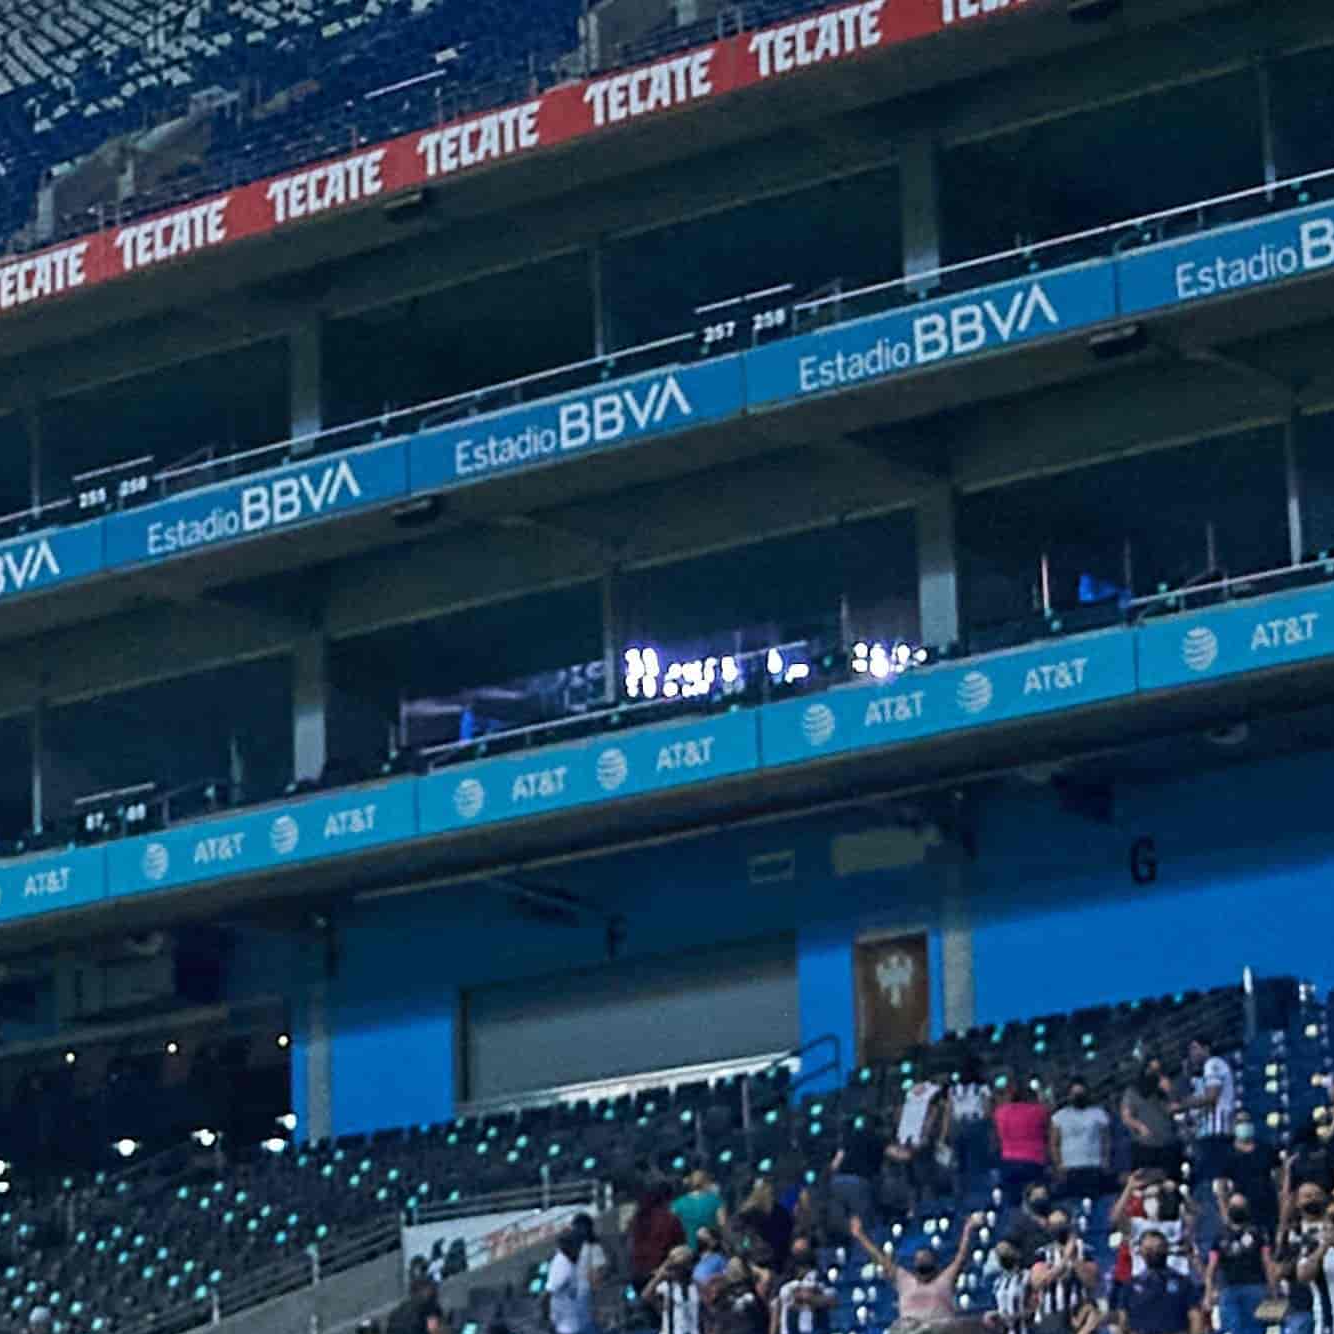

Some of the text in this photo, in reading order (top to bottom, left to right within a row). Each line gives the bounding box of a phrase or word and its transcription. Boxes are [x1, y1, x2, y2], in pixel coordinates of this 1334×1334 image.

[114, 197, 229, 270] TECATE
[267, 149, 386, 223] TECATE
[417, 101, 542, 176] TECATE
[583, 49, 715, 126] TECATE
[750, 0, 885, 78] TECATE
[1176, 240, 1299, 300] Estadio
[797, 284, 1059, 392] Estadio BBVA
[455, 377, 691, 475] Estadio BBVA
[147, 458, 361, 556] Estadio BBVA
[23, 868, 72, 898] AT&T
[193, 832, 246, 864] AT&T
[323, 804, 378, 840] AT&T
[511, 766, 568, 802] AT&T
[655, 736, 715, 771] AT&T
[864, 690, 925, 727] AT&T
[1023, 658, 1088, 695] AT&T
[1250, 612, 1320, 652] AT&T
[1130, 836, 1157, 885] G
